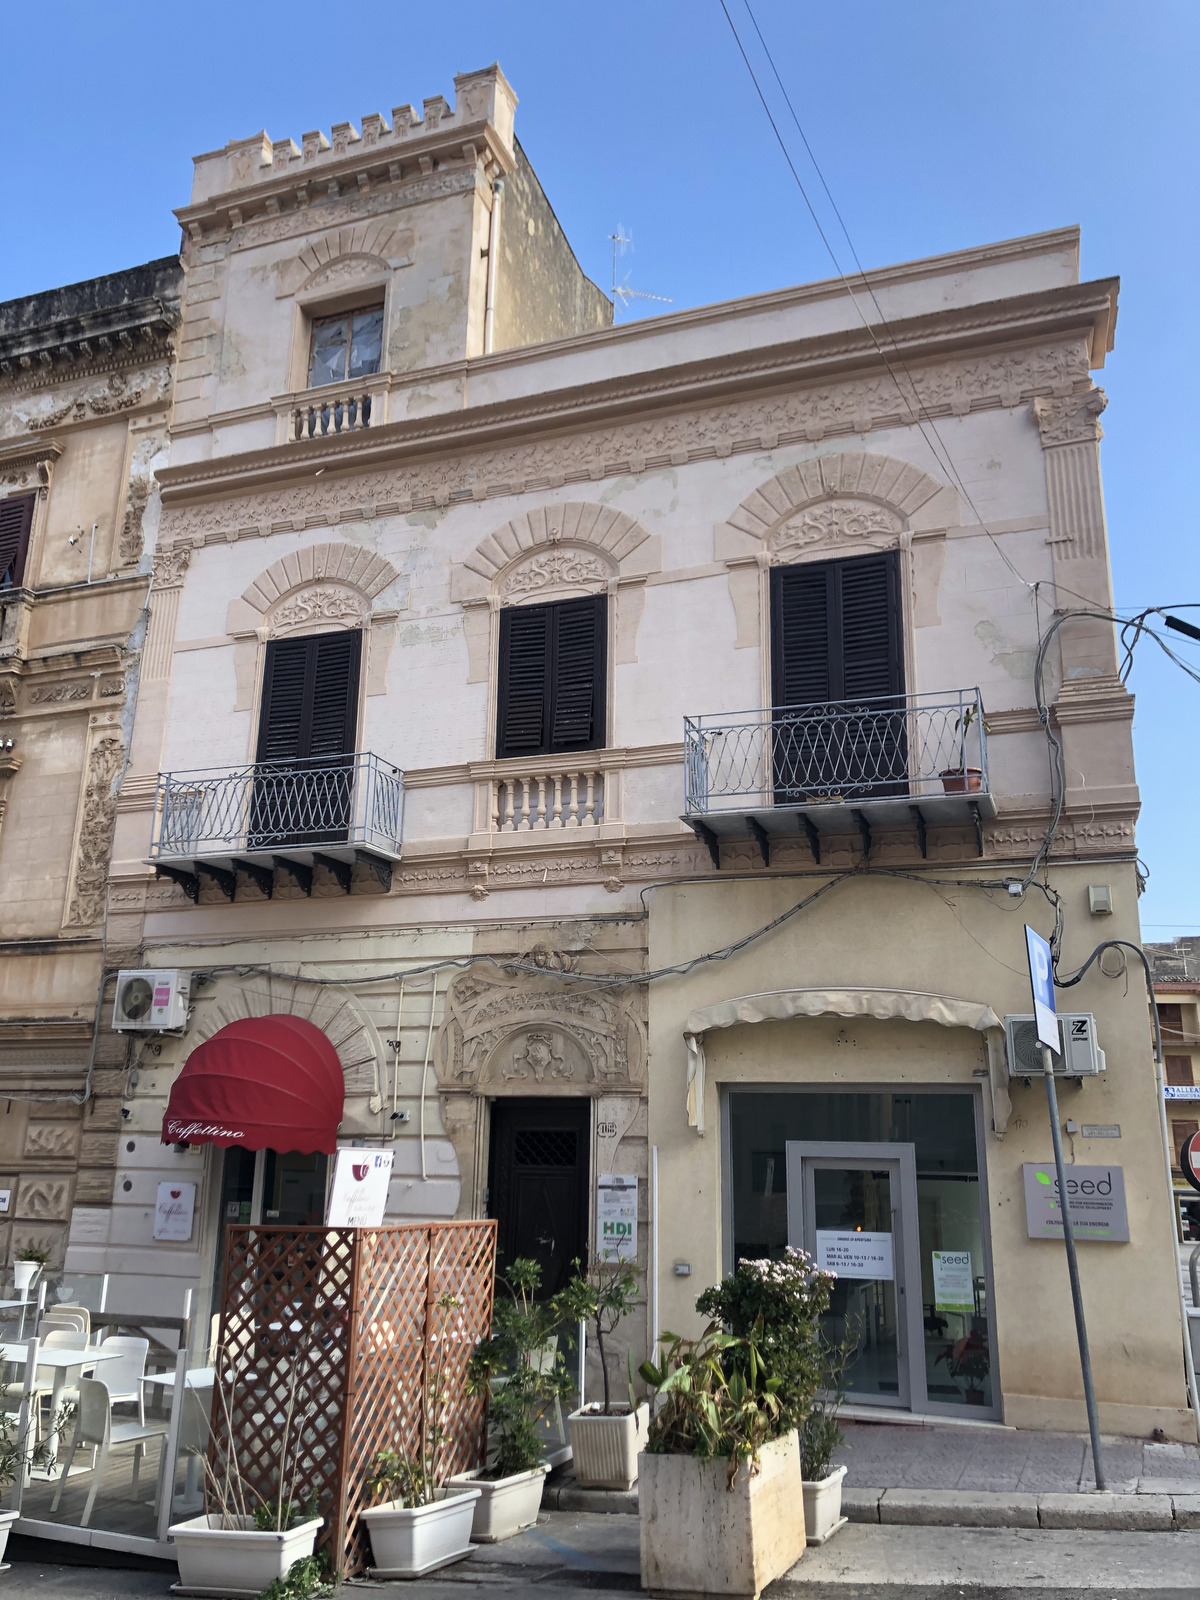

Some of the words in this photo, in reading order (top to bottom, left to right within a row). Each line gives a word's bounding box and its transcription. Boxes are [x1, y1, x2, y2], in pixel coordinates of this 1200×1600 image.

[1032, 938, 1049, 997] P
[168, 1120, 245, 1139] Caffettino
[1054, 1171, 1112, 1196] seed
[603, 1221, 632, 1235] HDI
[941, 1252, 970, 1265] seed
